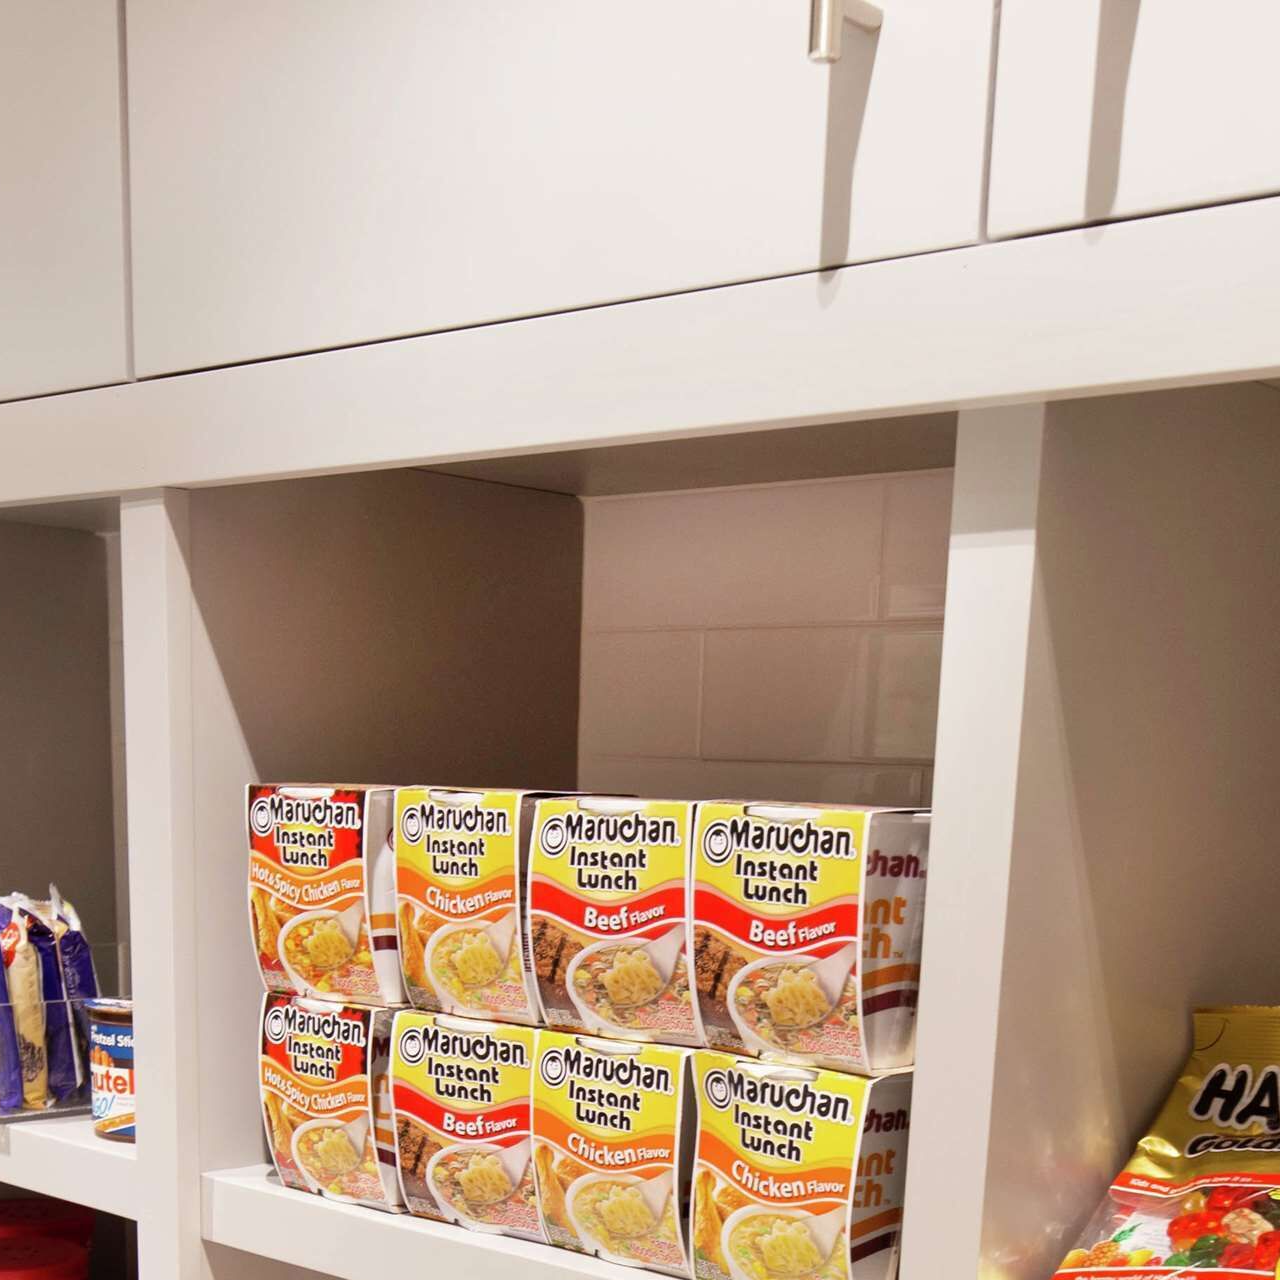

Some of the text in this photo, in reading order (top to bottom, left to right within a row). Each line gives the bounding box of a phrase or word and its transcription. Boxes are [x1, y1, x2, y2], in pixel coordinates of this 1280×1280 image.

[270, 798, 357, 828] Maruchan
[420, 804, 507, 833] Maruchan
[275, 826, 334, 848] Instant
[566, 814, 676, 845] Maruchan
[730, 820, 851, 857] Maruchan
[282, 847, 328, 867] Lunch
[426, 836, 485, 856] Instant
[570, 846, 646, 868] Instant
[432, 857, 479, 878] Lunch
[577, 868, 637, 891] Lunch
[735, 855, 818, 882] Instant
[302, 876, 340, 902] Chicken
[426, 887, 513, 915] Chicken Flavor
[743, 878, 807, 905] Lunch
[584, 904, 666, 931] Beef Flavor
[749, 921, 797, 947] Beef
[798, 921, 836, 943] Flavor
[284, 1008, 362, 1043] Maruchan
[287, 1037, 341, 1061] Instant
[423, 1028, 525, 1064] Maruchan
[92, 1068, 134, 1095] nutel
[293, 1057, 335, 1080] Lunch
[427, 1057, 499, 1084] Instant
[563, 1050, 669, 1092] Maruchan
[310, 1091, 346, 1111] Chicken
[435, 1079, 492, 1102] Lunch
[569, 1080, 640, 1111] Instant
[727, 1070, 849, 1122] Maruchan
[442, 1111, 518, 1135] Beef Flavor
[576, 1104, 631, 1131] Lunch
[734, 1104, 813, 1141] Instant
[567, 1132, 671, 1167] Chicken Flavor
[741, 1131, 801, 1162] Lunch
[731, 1159, 846, 1199] Chicken Flavor
